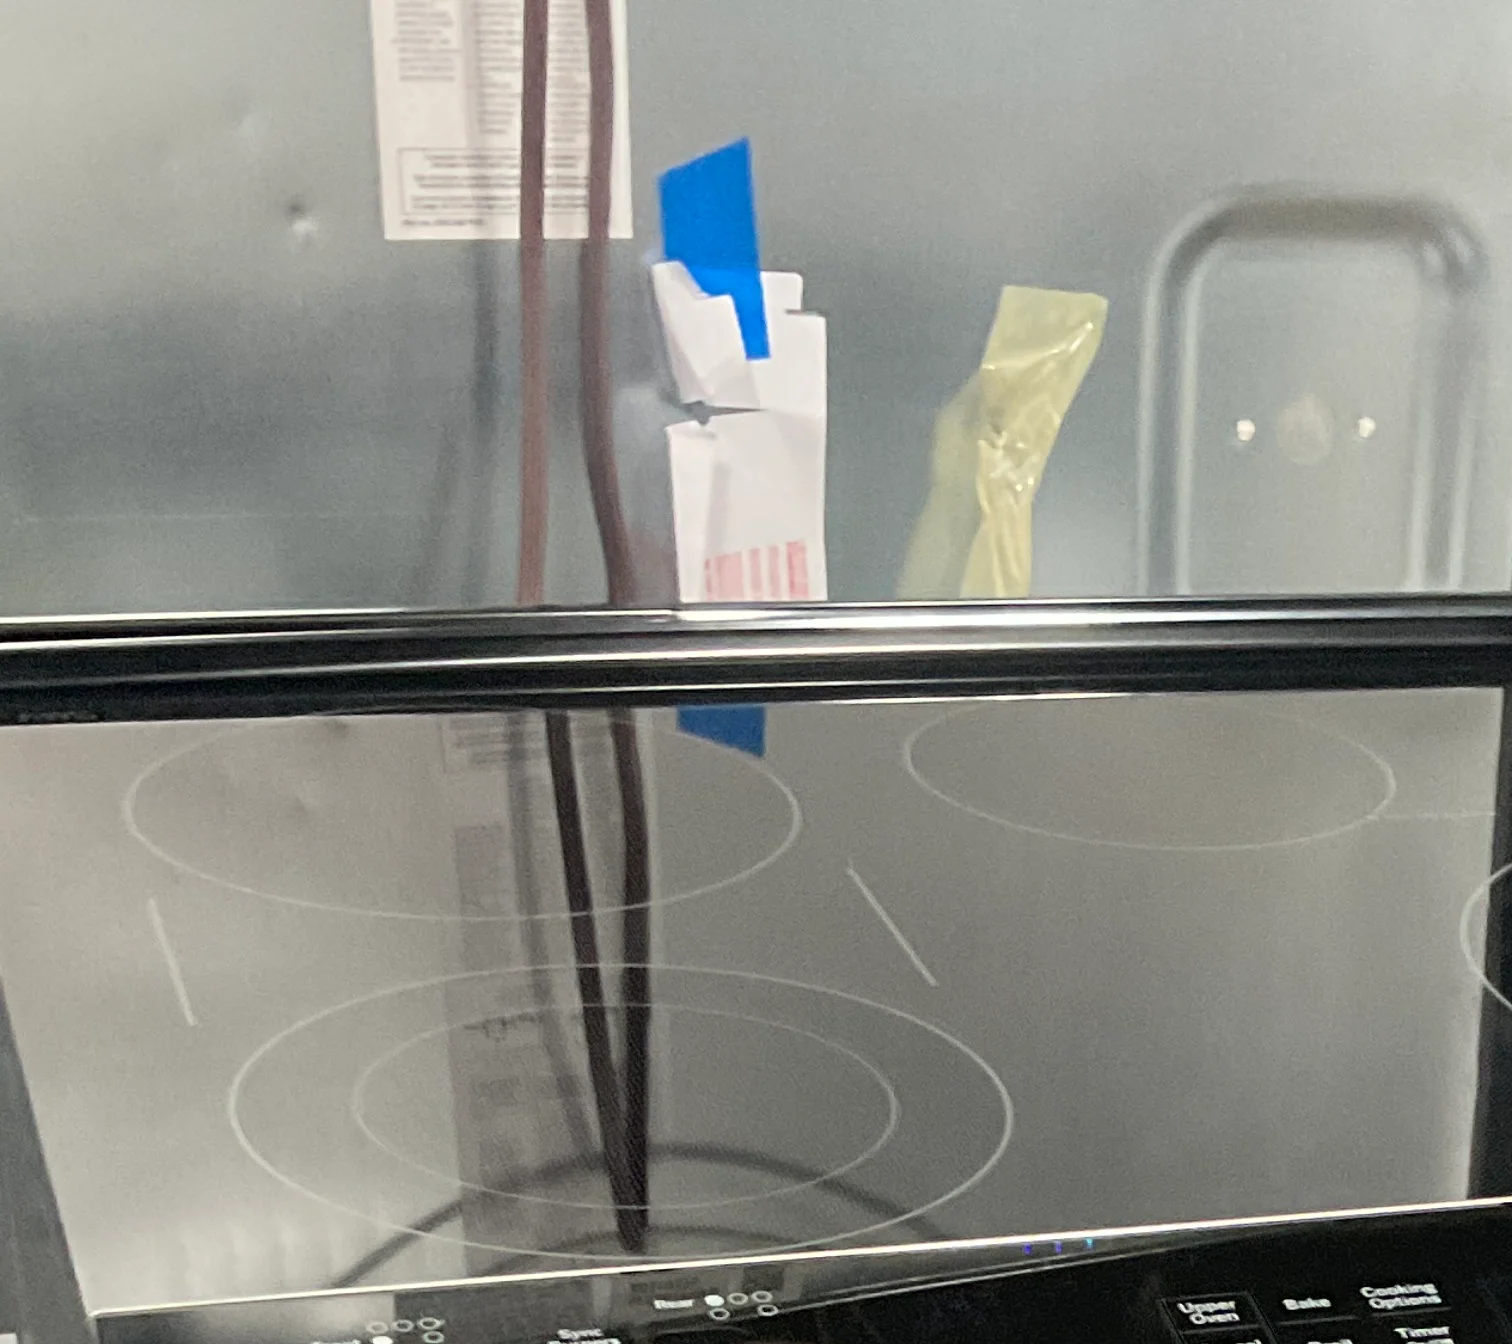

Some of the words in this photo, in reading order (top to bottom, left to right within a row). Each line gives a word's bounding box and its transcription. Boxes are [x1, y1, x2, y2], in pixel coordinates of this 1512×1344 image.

[1282, 1298, 1333, 1311] Bake
[1189, 1312, 1241, 1325] Oven
[1393, 1326, 1450, 1339] Timer
